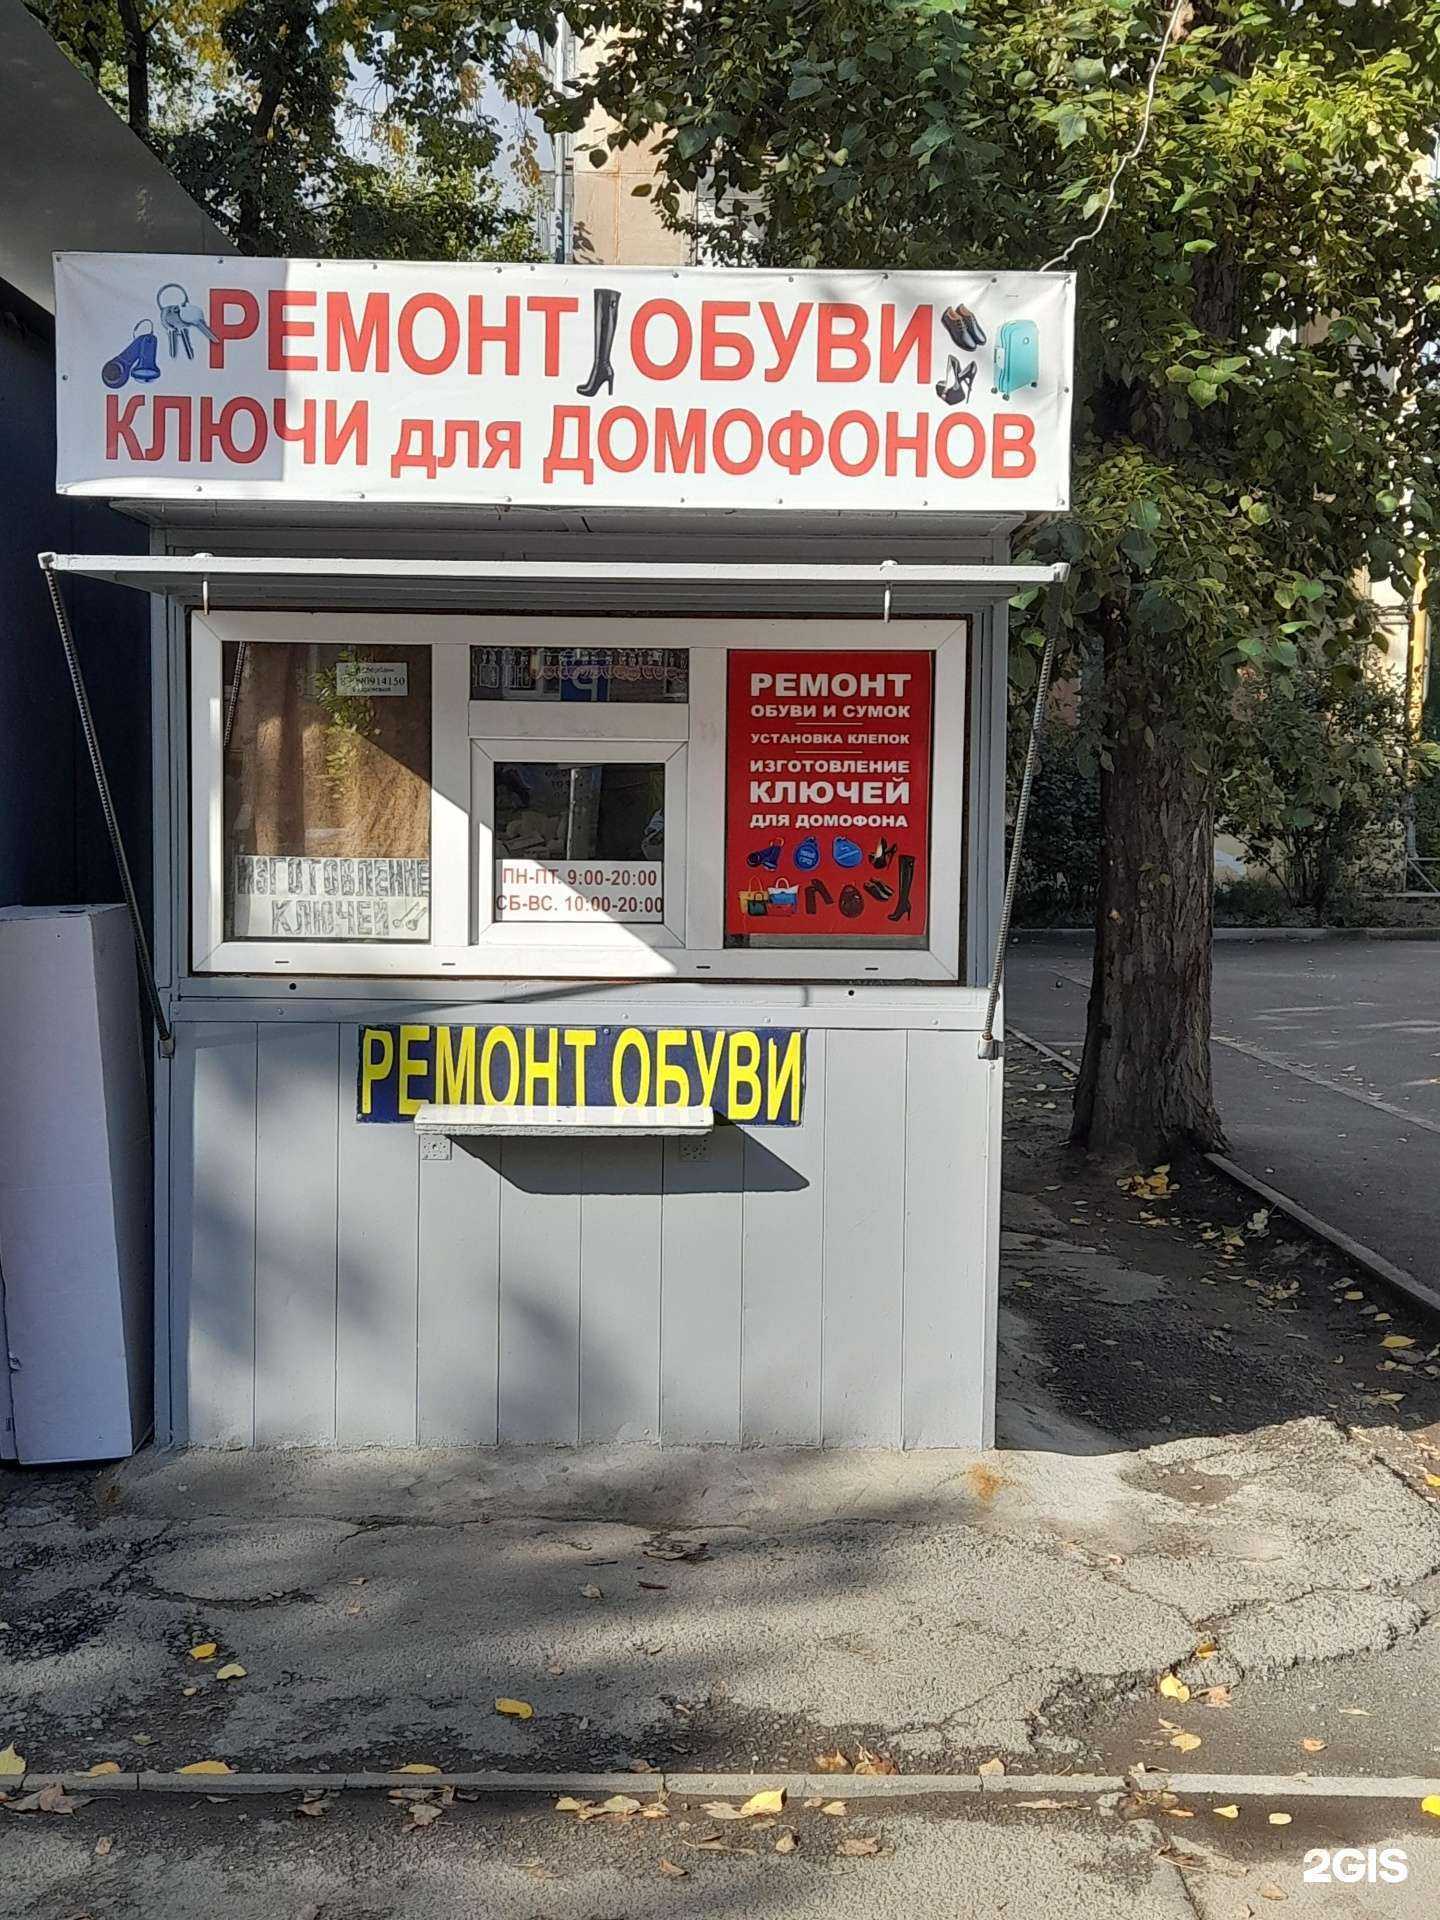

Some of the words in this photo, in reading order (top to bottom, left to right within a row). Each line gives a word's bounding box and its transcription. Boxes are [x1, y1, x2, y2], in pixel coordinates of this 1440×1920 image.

[208, 287, 579, 378] РЕМОНТ
[629, 297, 934, 386] ОБУВИ
[105, 393, 368, 467] КЛЮЧИ
[542, 404, 1038, 486] ДОМОФОНОВ
[750, 672, 912, 698] РЕМОНТ
[751, 704, 817, 718] ОБУВИ
[823, 705, 837, 718] И
[842, 705, 911, 719] СУМОК
[751, 733, 843, 744] УСТАНОВКА
[847, 734, 910, 745] КЛЕПОК
[750, 759, 910, 774] ИЗГОТОВЛЕНИЕ
[750, 776, 910, 805] КЛЮЧЕЙ
[750, 814, 790, 829] ДЛЯ
[795, 814, 909, 830] ДОМОФОНА
[237, 857, 430, 898] ИЗГОТОВЛЕНИЕ
[502, 867, 562, 885] ПН-ПТ.
[567, 868, 657, 886] 9:00-20:00
[496, 894, 558, 912] СБ-ВС.
[565, 896, 663, 913] 10:00-20:00
[362, 1025, 597, 1115] РЕМОНТ
[611, 1027, 801, 1121] ОБУВИ
